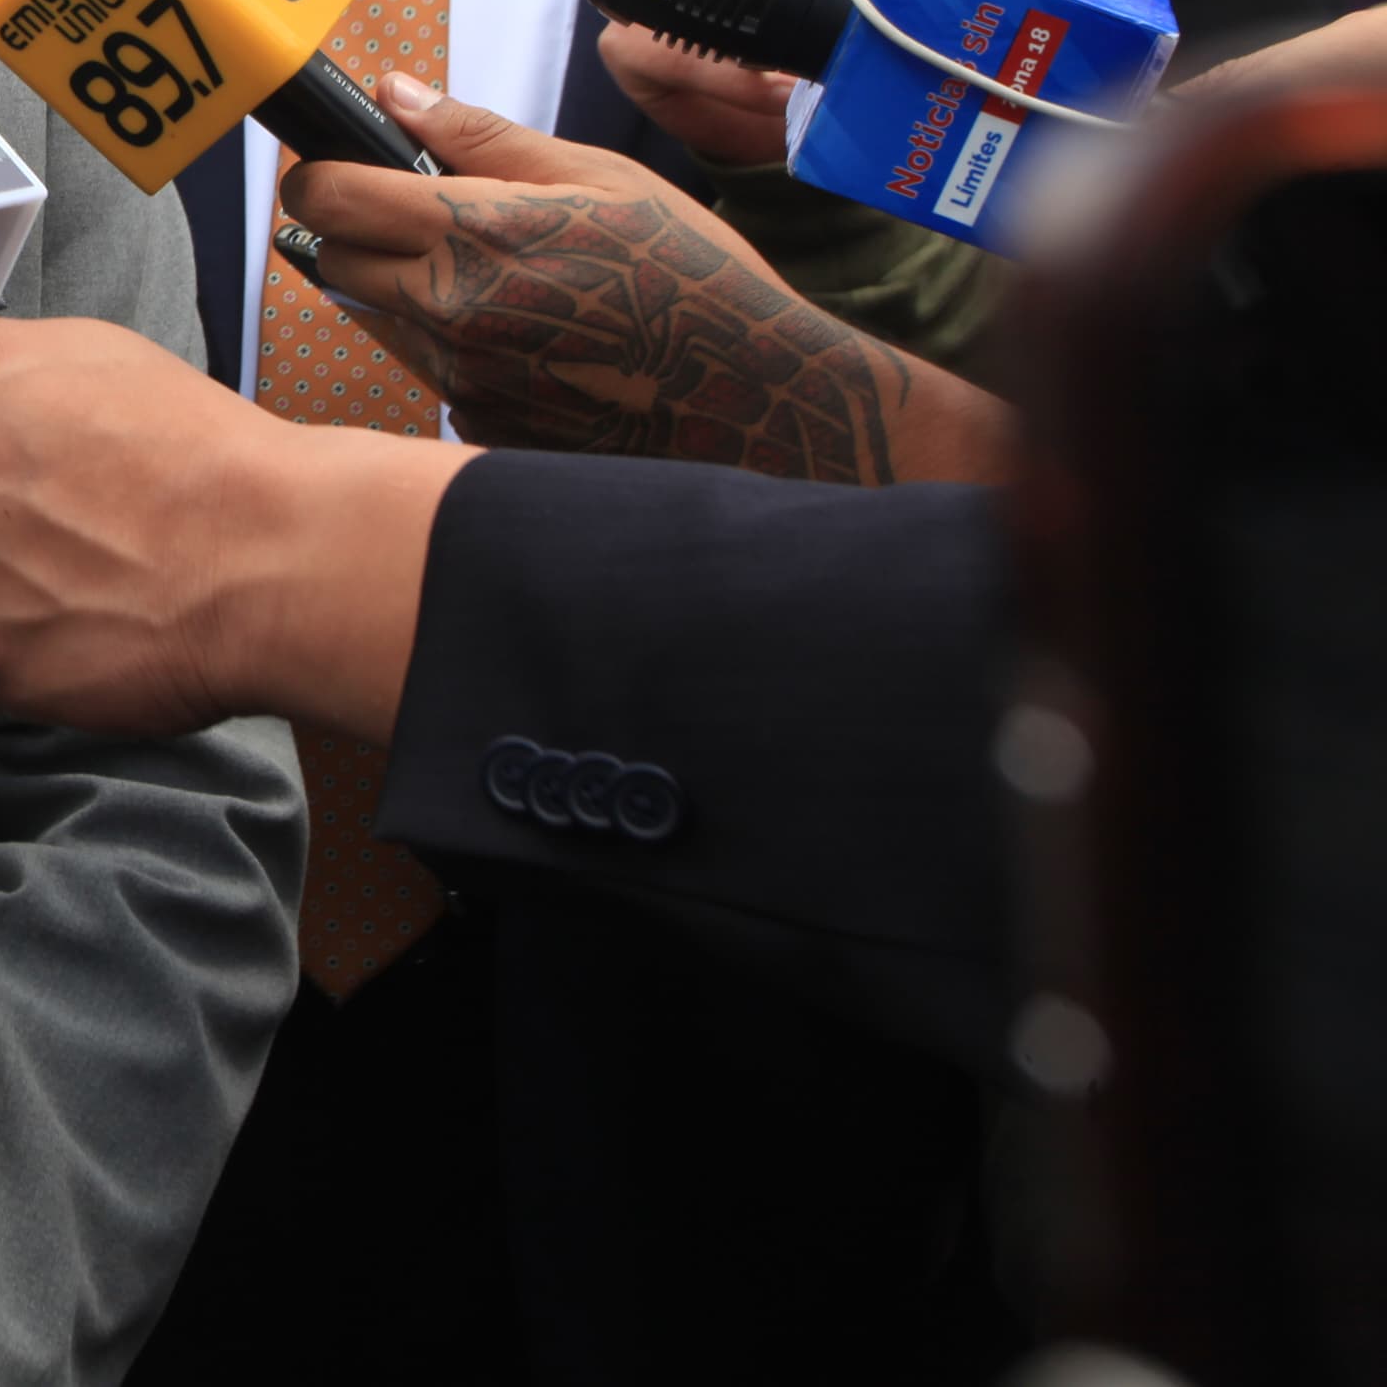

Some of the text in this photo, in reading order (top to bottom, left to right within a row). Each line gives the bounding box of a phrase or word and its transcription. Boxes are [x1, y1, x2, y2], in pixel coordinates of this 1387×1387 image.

[960, 2, 1005, 54] sin
[1028, 26, 1051, 55] 18
[323, 63, 388, 125] SENNHEISER
